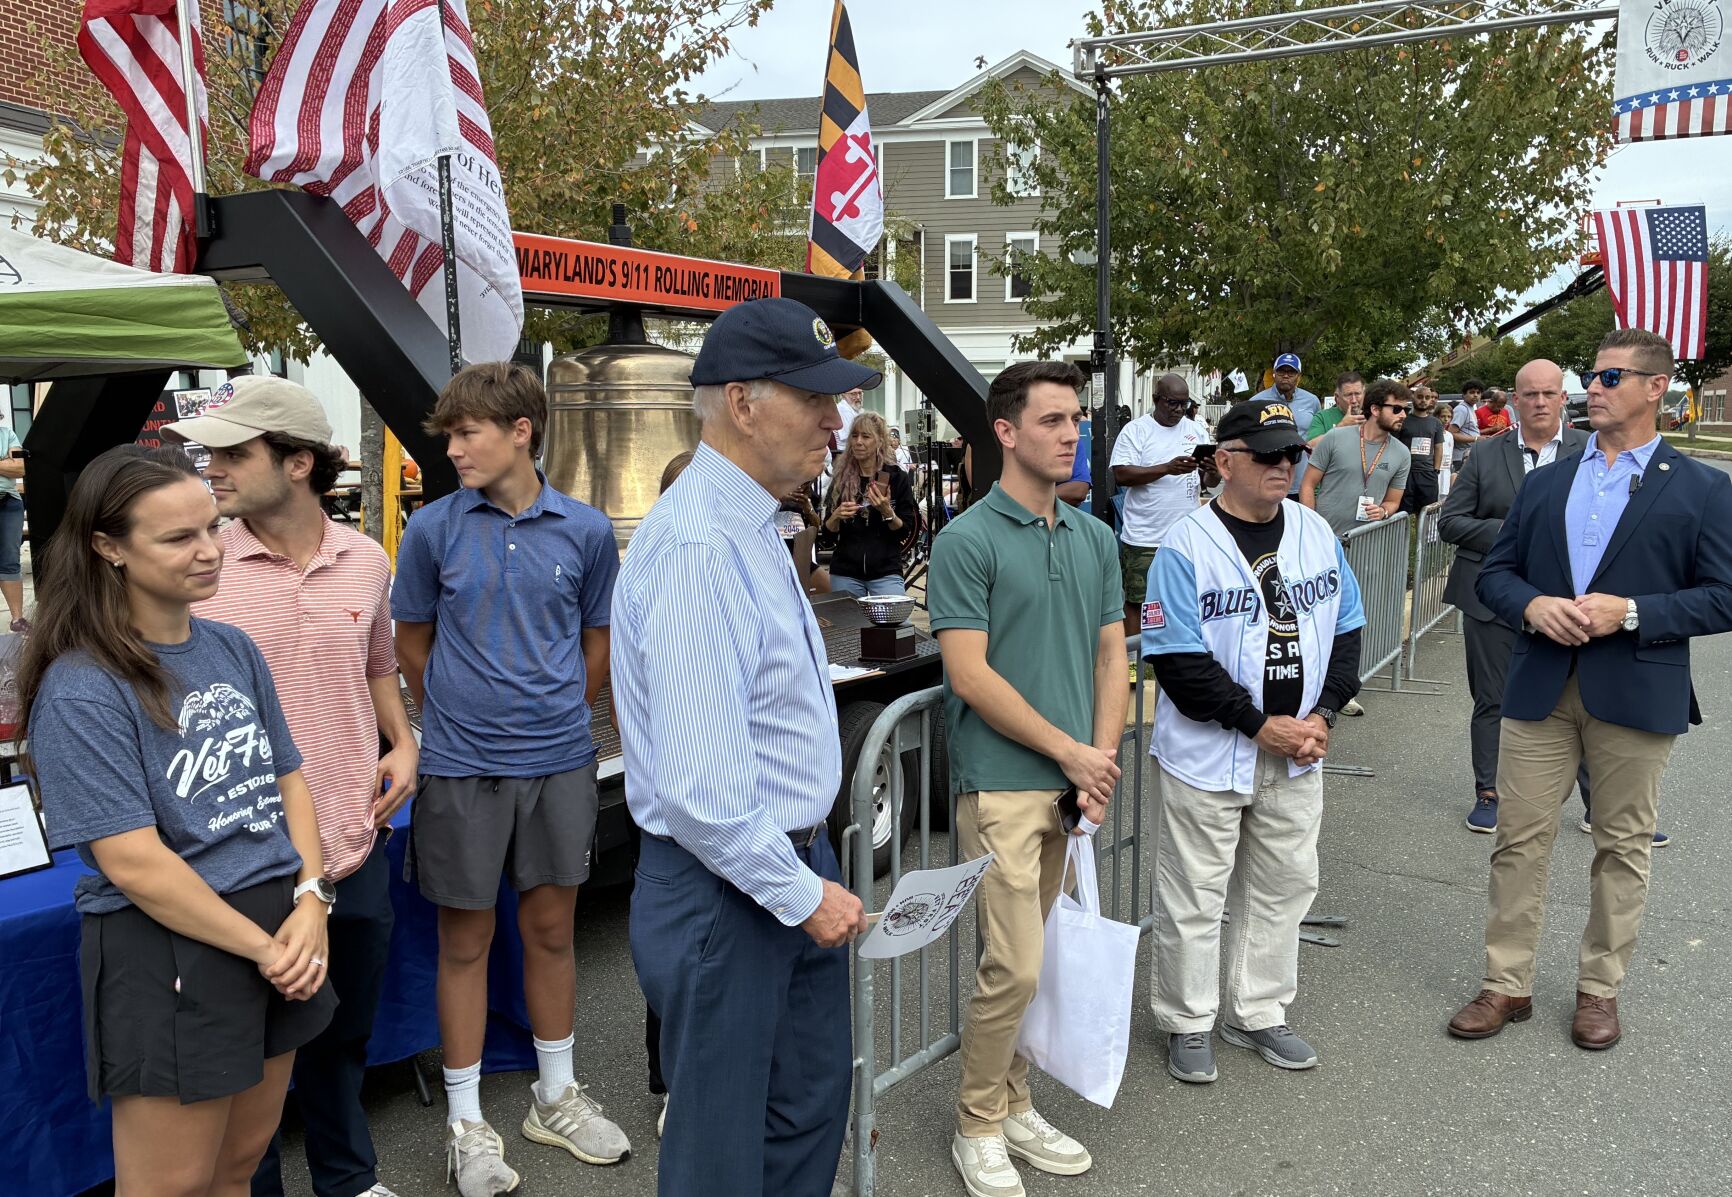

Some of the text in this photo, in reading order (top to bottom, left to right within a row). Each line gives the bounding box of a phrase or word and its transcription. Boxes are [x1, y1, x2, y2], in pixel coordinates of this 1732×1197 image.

[1645, 41, 1721, 70] RUN RUCK WALK
[457, 181, 469, 194] the
[459, 219, 478, 238] never
[516, 246, 617, 288] MARYLAND'S
[621, 260, 649, 292] 9/11
[654, 265, 710, 298] ROLLING
[1253, 556, 1278, 578] ROUDLY
[1199, 568, 1339, 622] BLUE ROCKS
[1266, 663, 1300, 680] TIME
[166, 737, 233, 800] Vet
[207, 806, 254, 832] Honoring
[249, 820, 273, 833] OUR
